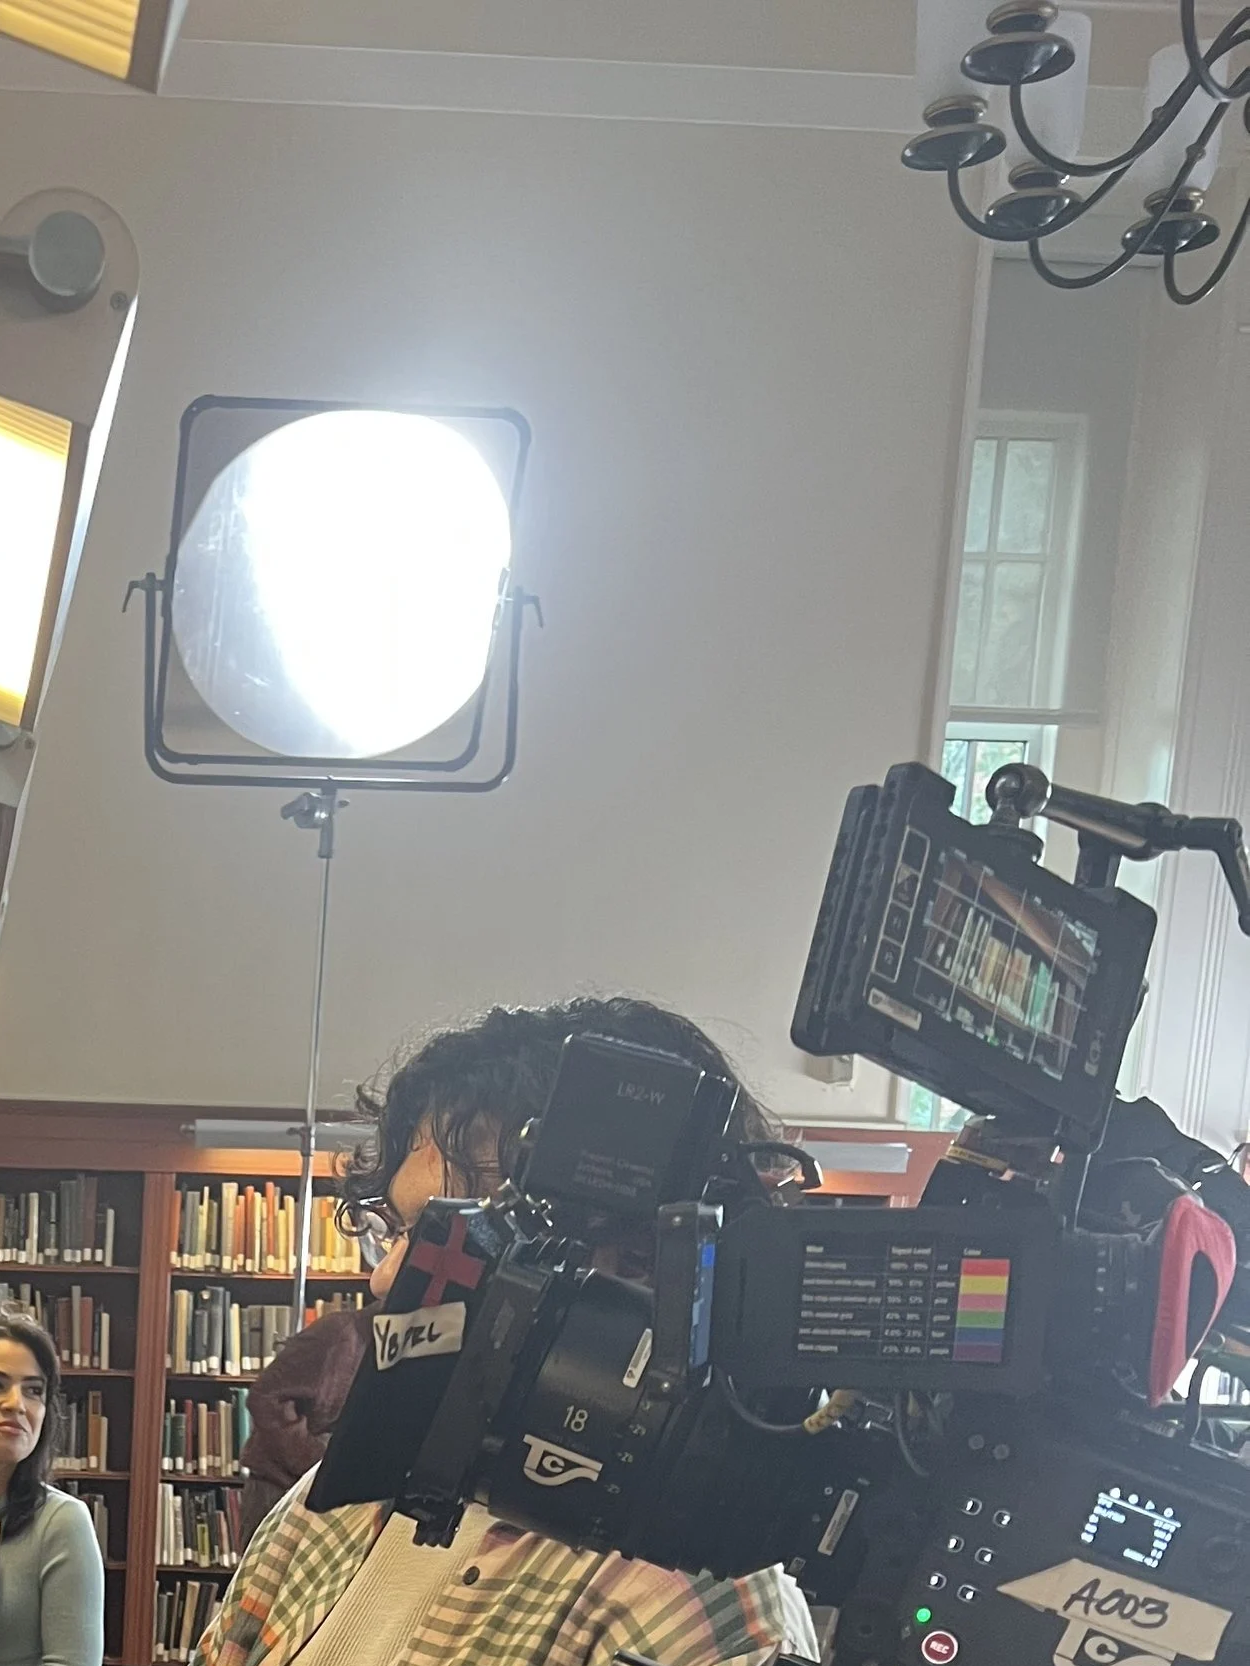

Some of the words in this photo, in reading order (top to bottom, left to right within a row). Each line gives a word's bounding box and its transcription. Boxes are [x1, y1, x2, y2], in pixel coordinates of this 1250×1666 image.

[563, 1404, 588, 1432] 18
[1063, 1577, 1170, 1629] A003
[928, 1639, 950, 1655] REC
